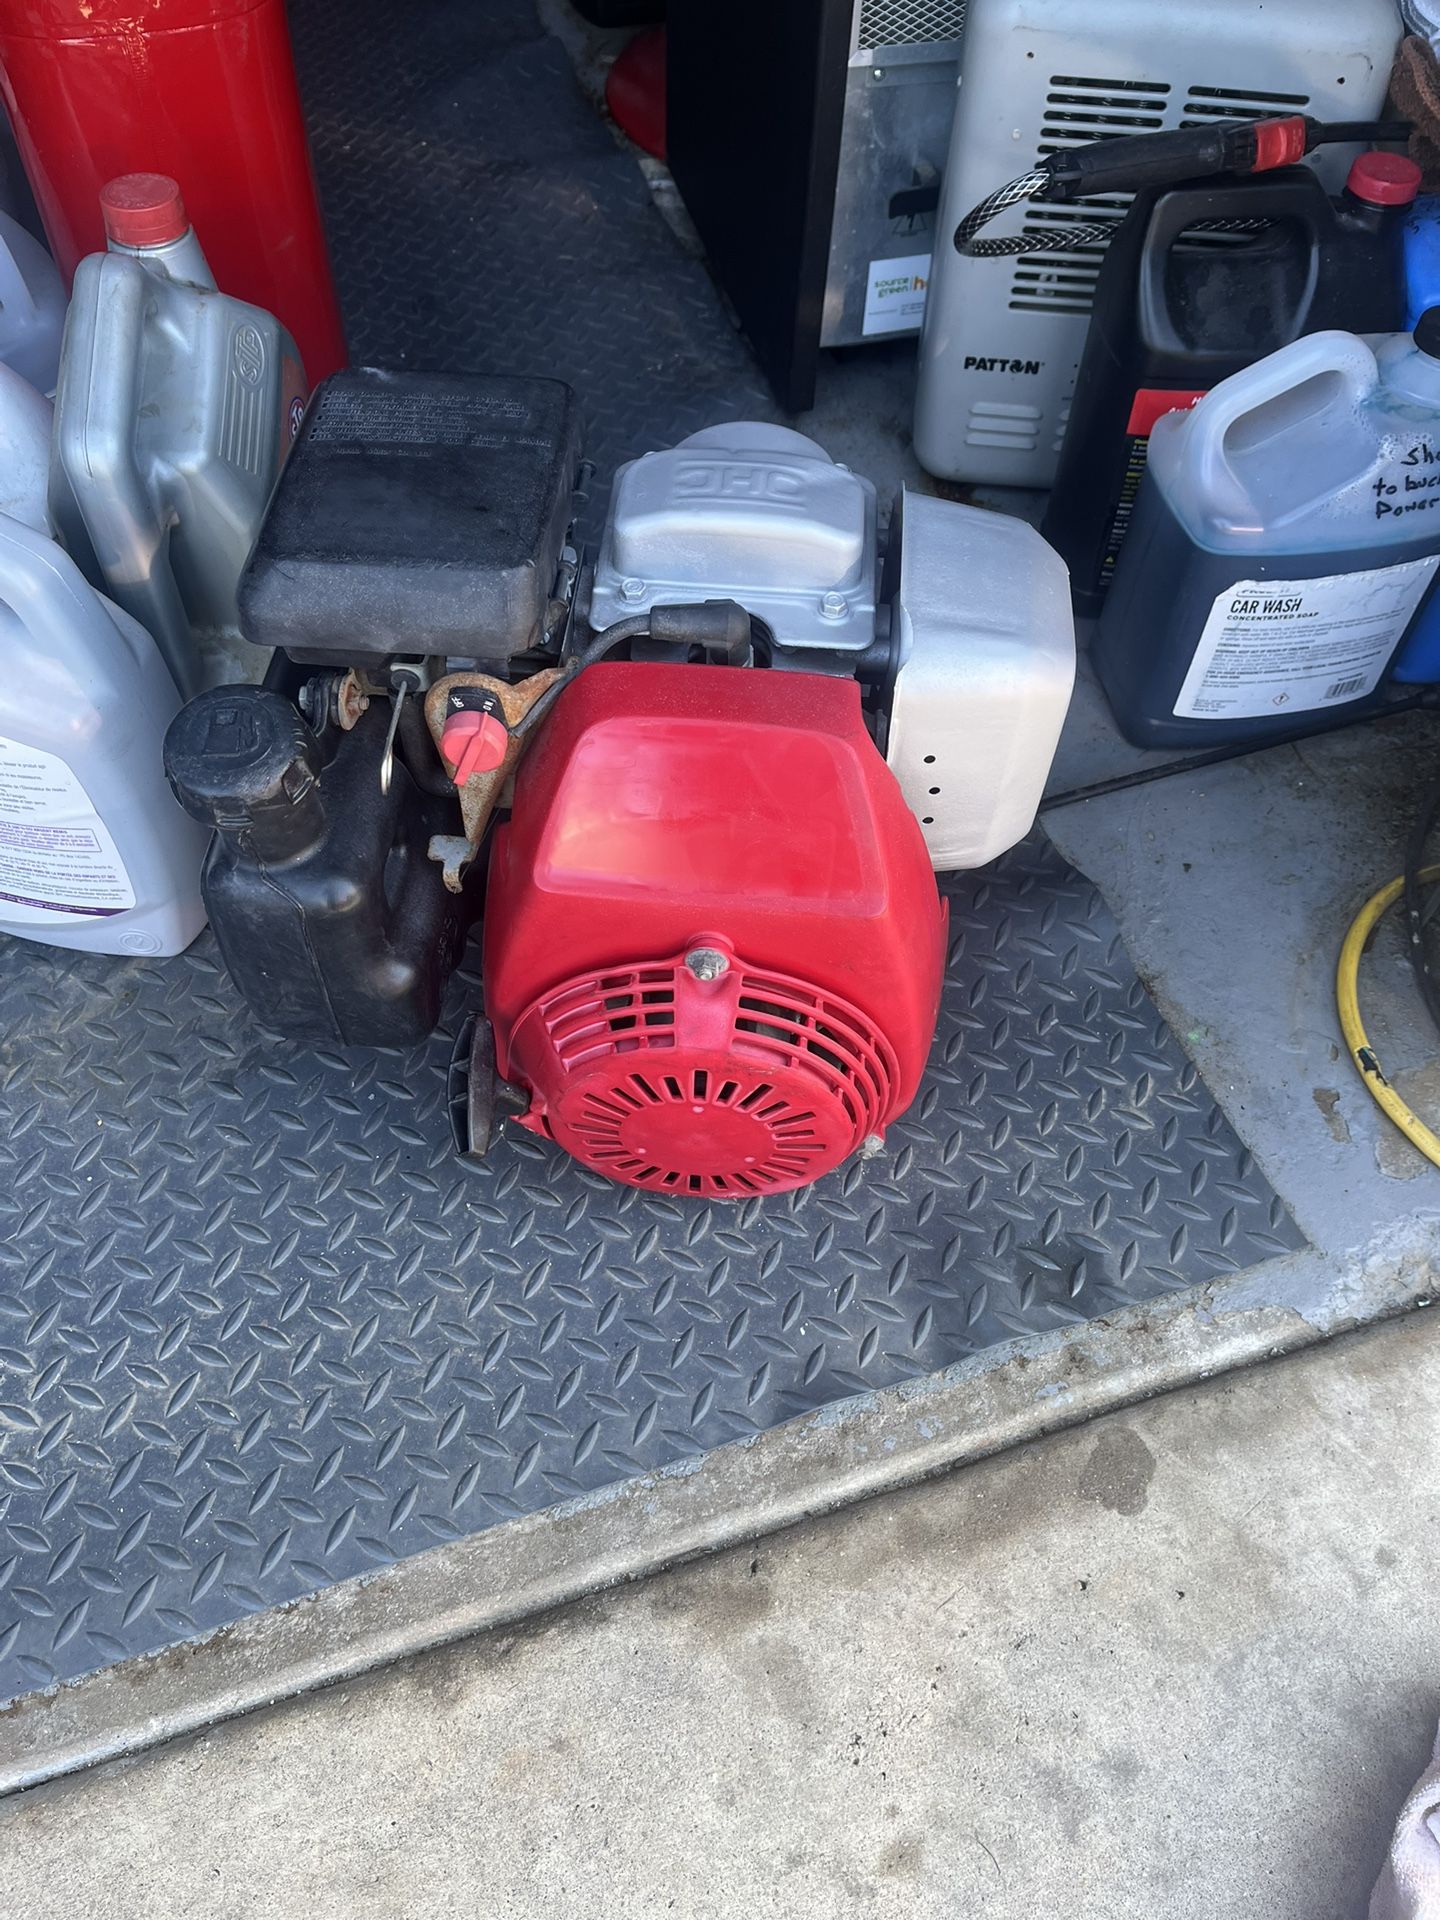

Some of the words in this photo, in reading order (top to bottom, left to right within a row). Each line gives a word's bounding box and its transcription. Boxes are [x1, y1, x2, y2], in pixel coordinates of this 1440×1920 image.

[912, 275, 928, 291] h
[235, 328, 261, 385] STP
[963, 356, 1040, 375] PATTON
[1372, 477, 1397, 497] to
[1230, 600, 1260, 614] CAR
[1262, 598, 1303, 614] WASH
[1226, 613, 1295, 621] CONCENTRATED
[1296, 611, 1319, 619] SOAP
[451, 696, 464, 708] OFF
